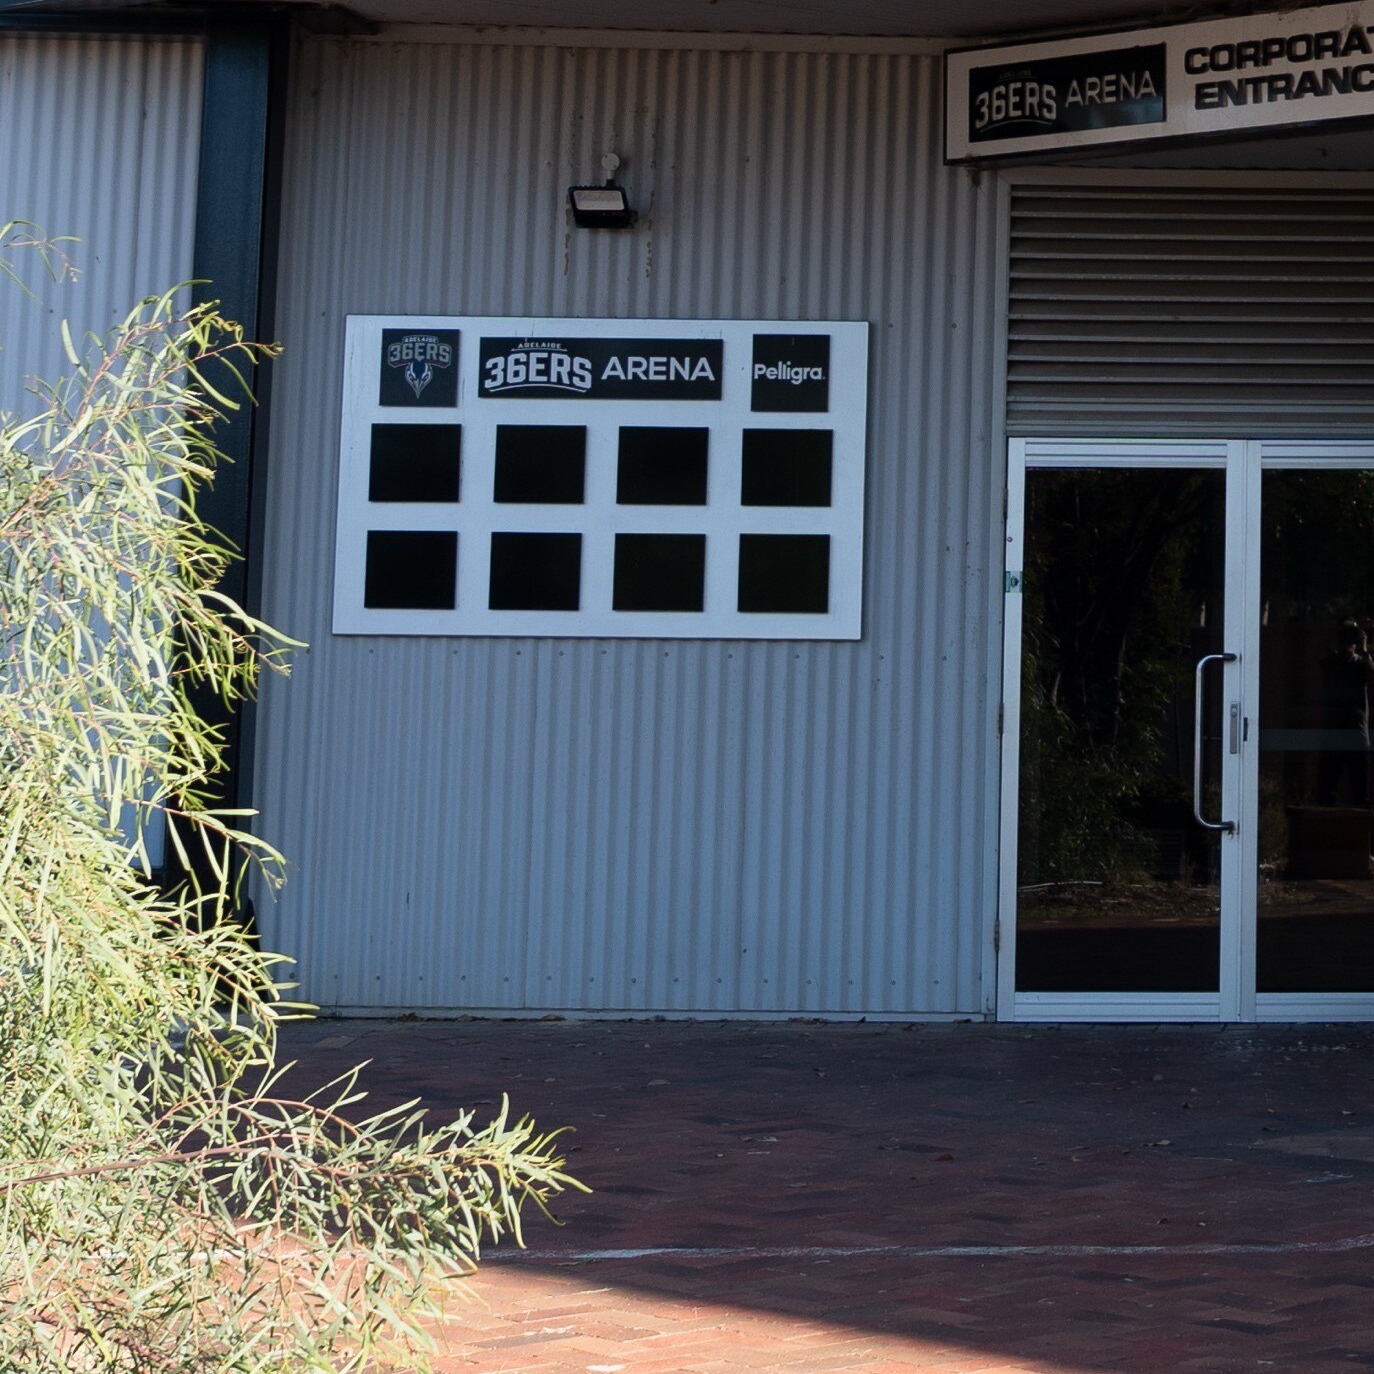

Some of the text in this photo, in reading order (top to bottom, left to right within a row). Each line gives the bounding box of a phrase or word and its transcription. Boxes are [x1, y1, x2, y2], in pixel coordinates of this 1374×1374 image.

[975, 70, 1157, 129] 36ERS ARENA
[389, 342, 450, 363] 36ERS
[484, 352, 715, 390] 36ERS ARENA
